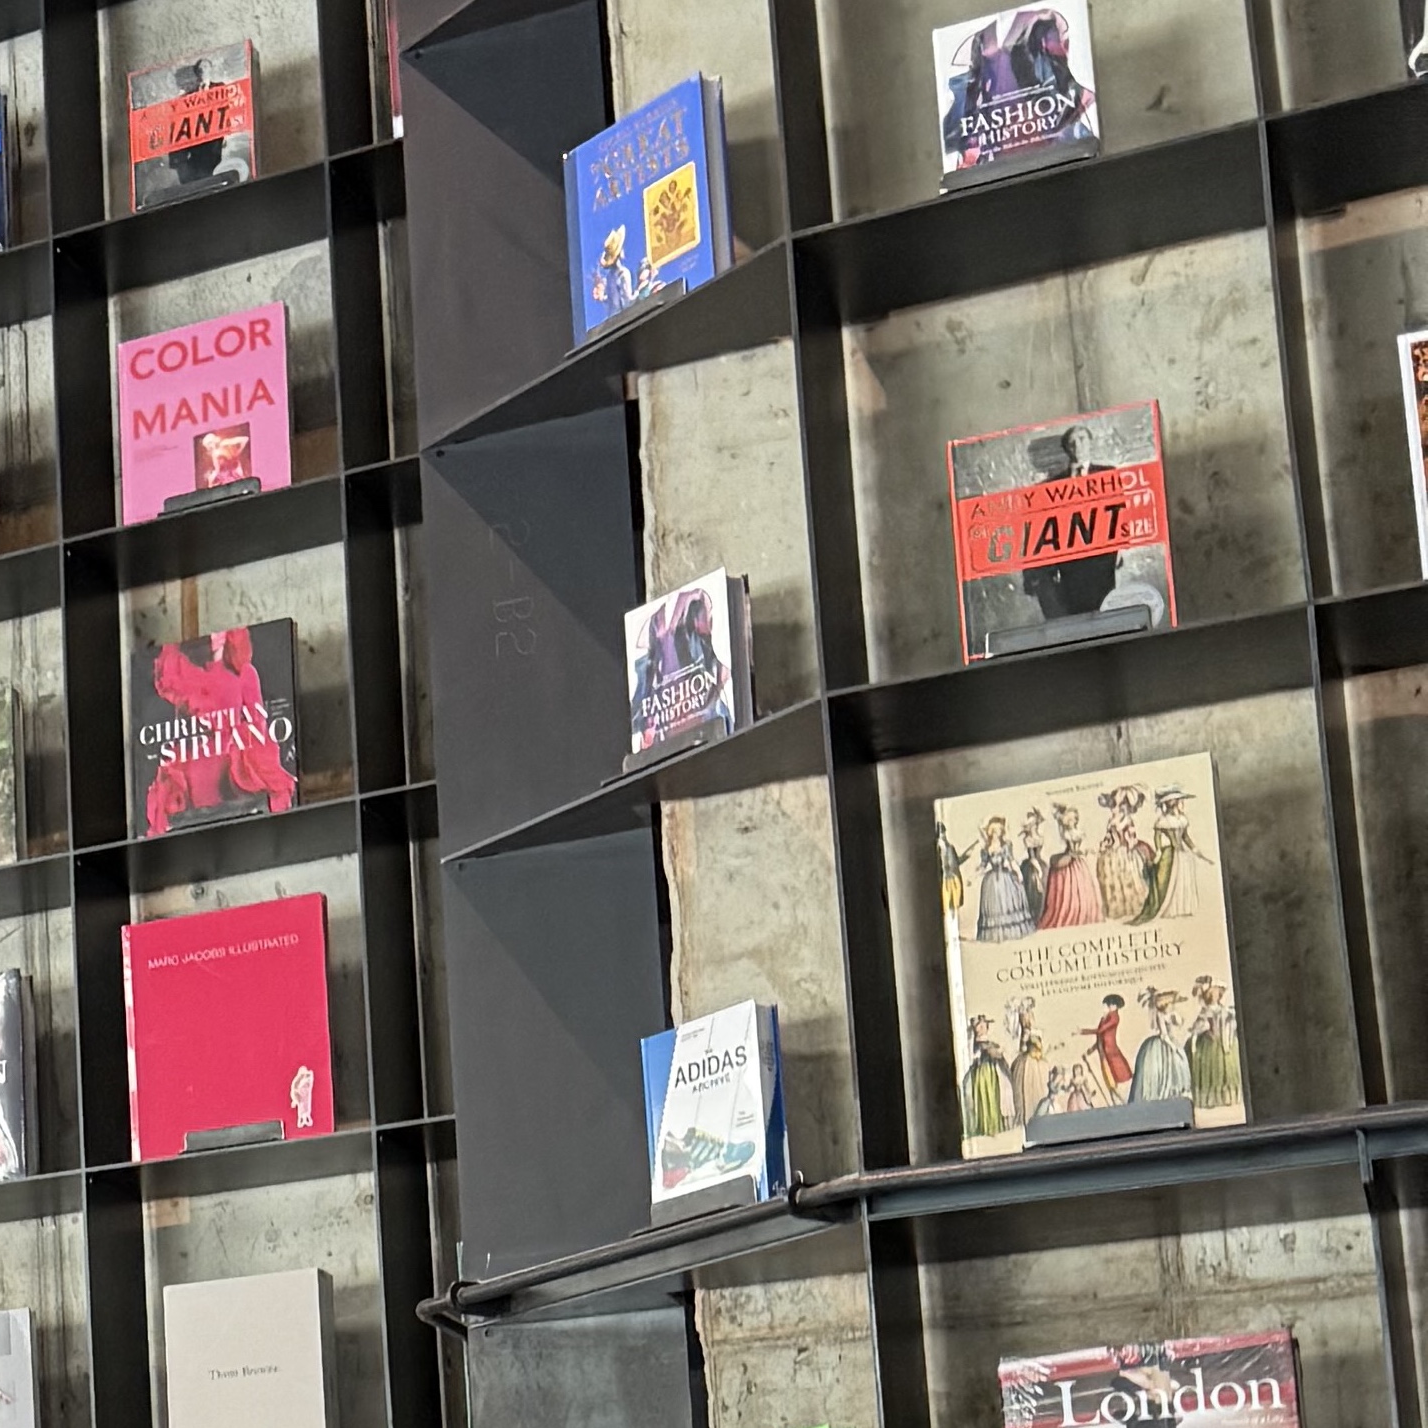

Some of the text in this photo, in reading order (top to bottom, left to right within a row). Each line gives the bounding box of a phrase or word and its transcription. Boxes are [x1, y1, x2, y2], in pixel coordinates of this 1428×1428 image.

[961, 92, 1077, 136] FASHION
[978, 119, 1060, 145] HISTORY
[130, 318, 272, 382] COLOR
[132, 378, 275, 440] MANIA
[1046, 468, 1150, 503] WARHOL
[1121, 517, 1155, 537] SIZE
[641, 671, 718, 718] FASHION
[658, 693, 705, 724] HISTORY
[139, 703, 269, 746] CHRISTIAN
[159, 716, 293, 767] SIRIANO
[228, 933, 299, 957] ILLUSTRATED
[997, 956, 1092, 983] COSTUME
[1097, 942, 1185, 968] HISTORY
[1014, 927, 1163, 964] THE COMPLETE
[674, 1045, 748, 1088] ADIDAS
[1054, 1368, 1285, 1427] London
